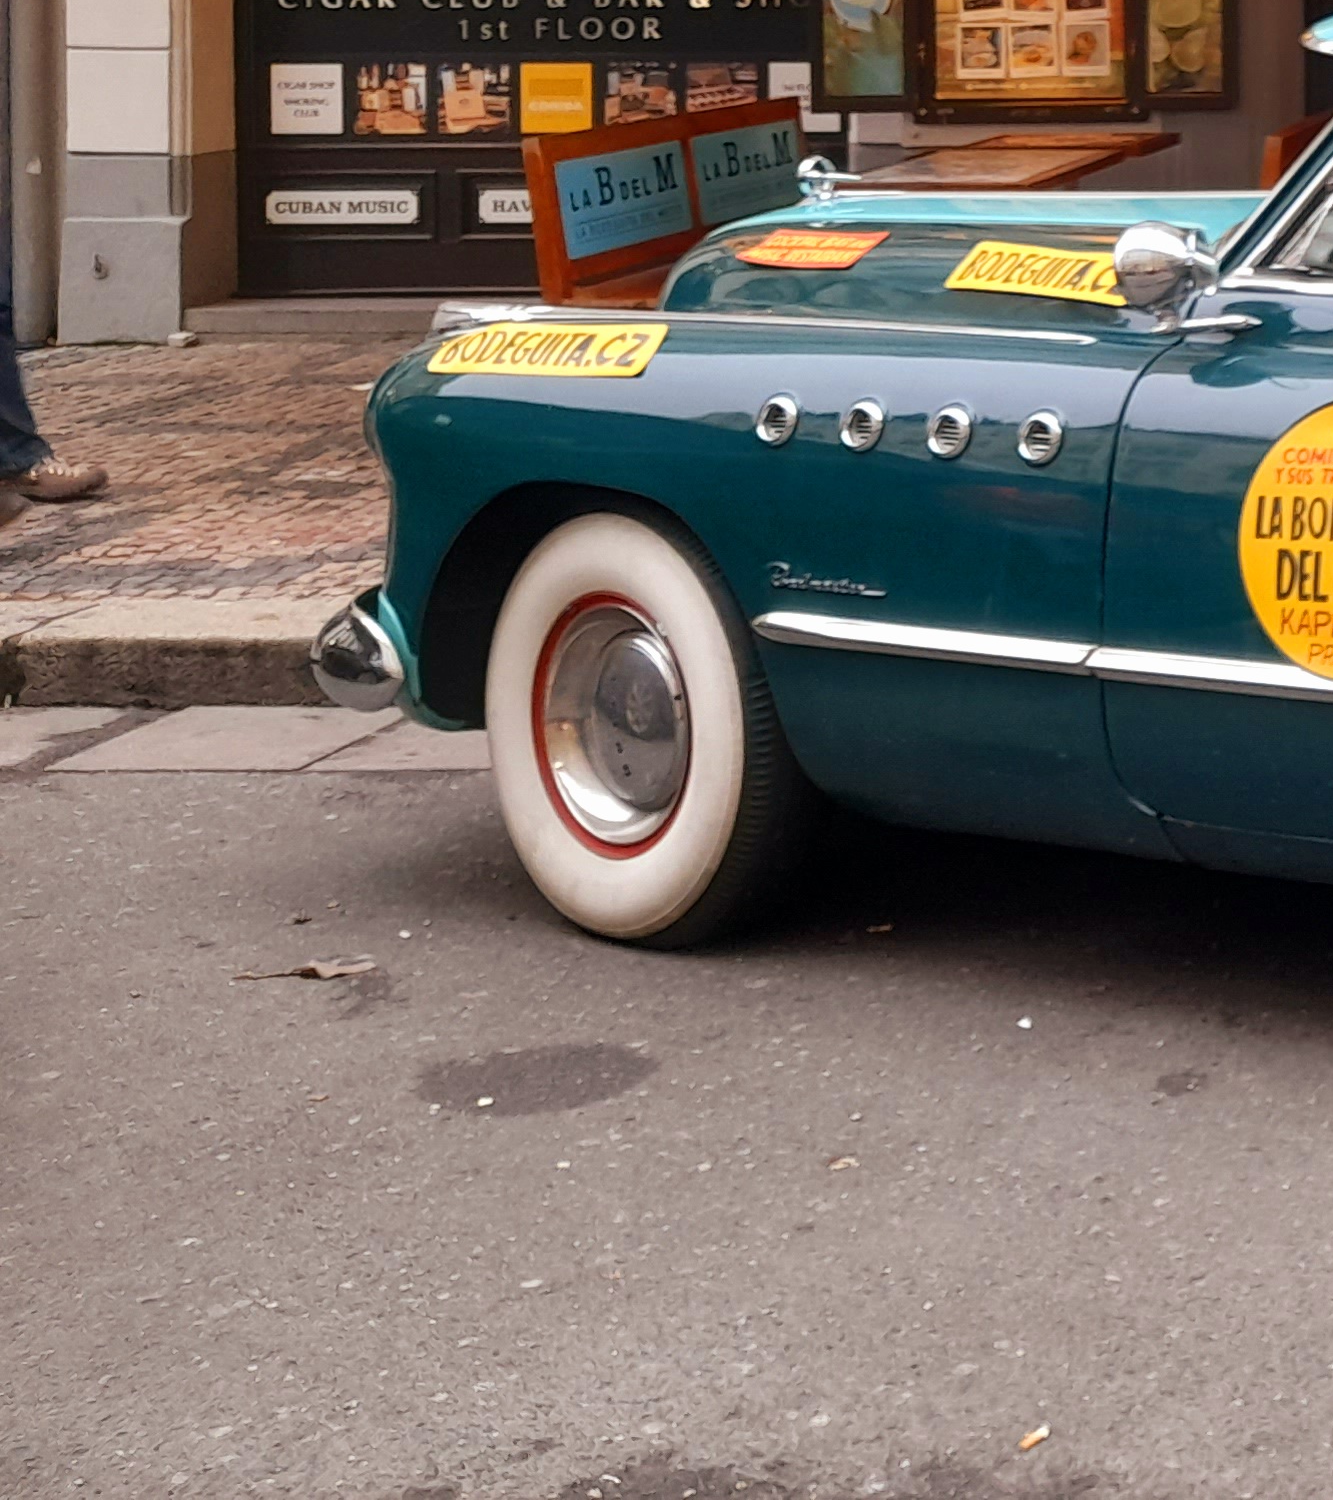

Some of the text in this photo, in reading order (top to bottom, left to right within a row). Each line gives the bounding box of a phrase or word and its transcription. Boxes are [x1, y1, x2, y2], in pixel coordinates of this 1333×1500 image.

[458, 17, 663, 41] 1st FLOOR
[273, 201, 410, 215] CUBAN MUSIC
[958, 250, 1118, 294] BODEGUITA.C
[439, 331, 651, 368] BODEGUITA.CZ
[1275, 468, 1285, 484] Y
[1287, 468, 1315, 485] SUS
[1255, 495, 1284, 541] LA
[1276, 548, 1329, 603] DEL
